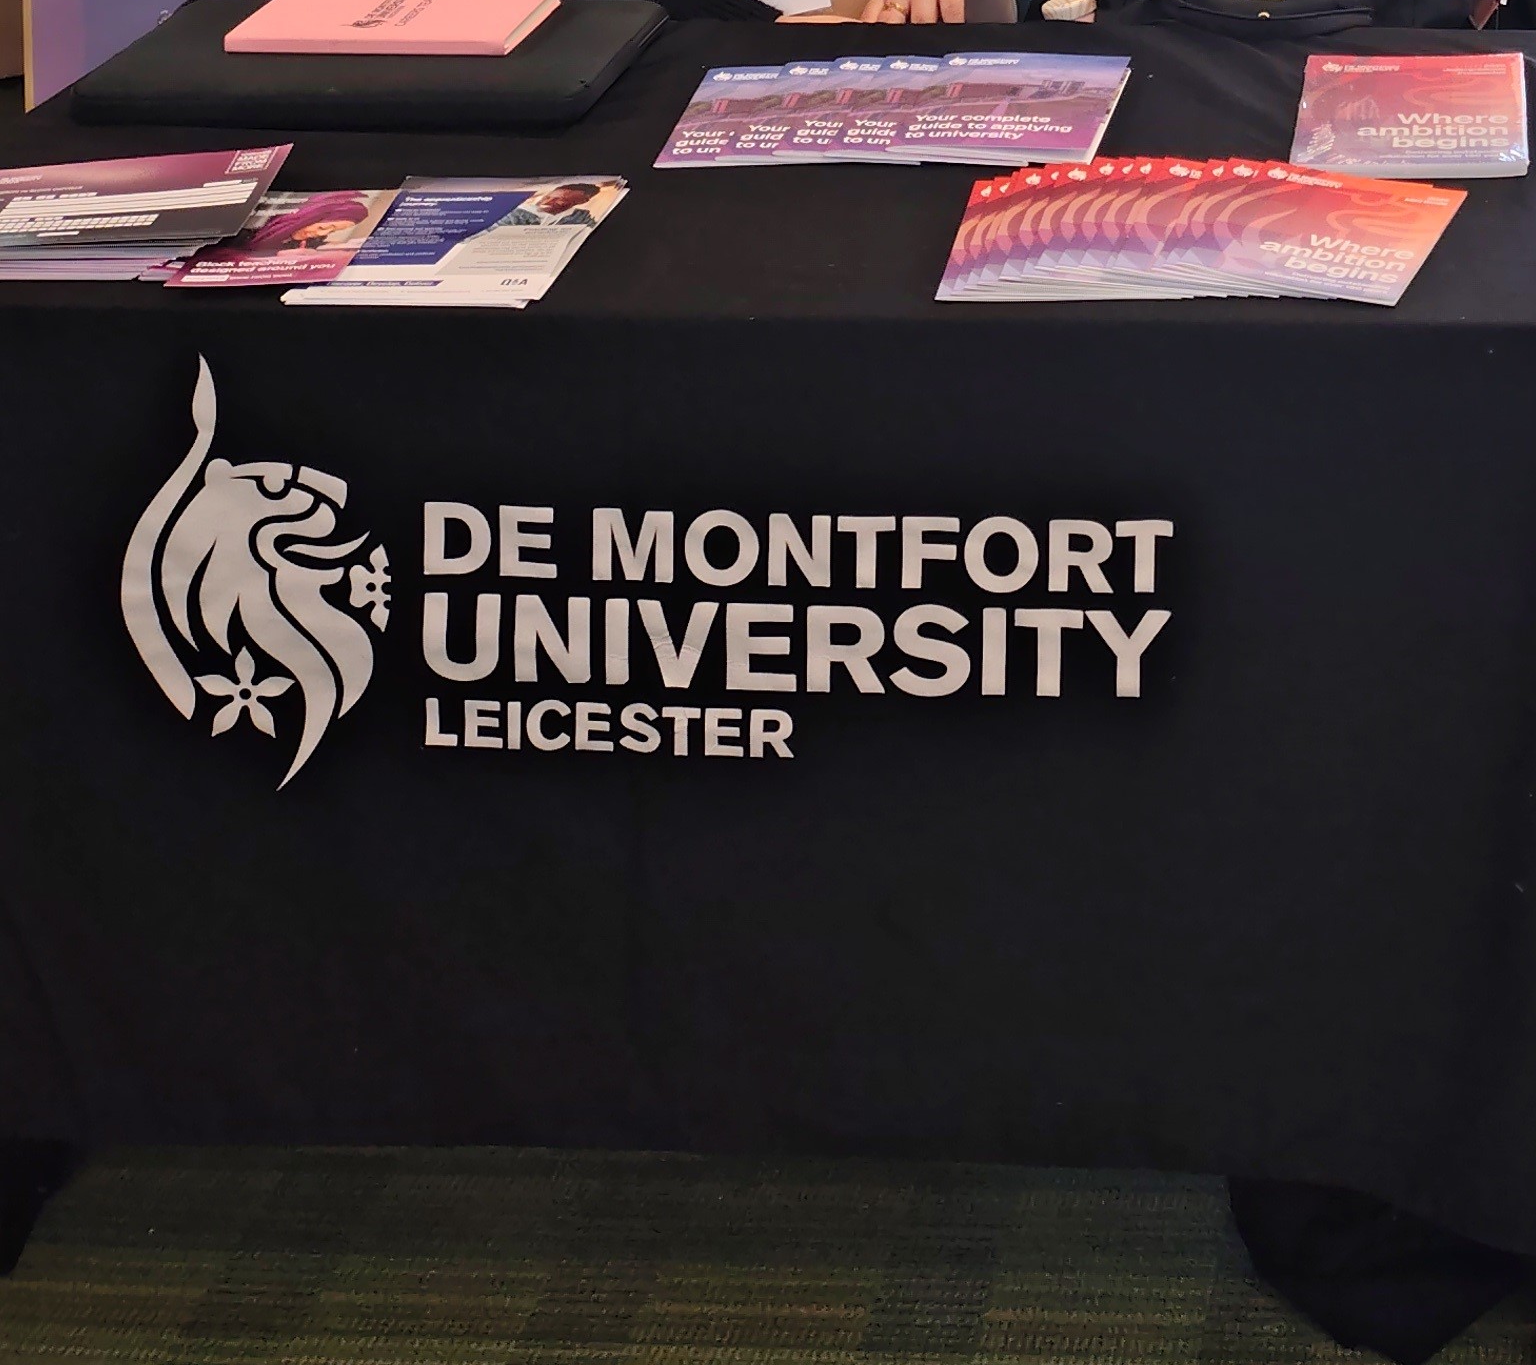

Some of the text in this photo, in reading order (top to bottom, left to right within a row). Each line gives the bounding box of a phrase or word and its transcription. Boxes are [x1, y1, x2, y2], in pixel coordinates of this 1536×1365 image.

[908, 122, 963, 131] guide
[990, 124, 1073, 133] applying
[915, 114, 1051, 123] Your complete
[1397, 113, 1508, 124] Where
[905, 129, 1024, 139] to university
[1357, 125, 1508, 137] ambition
[1392, 137, 1510, 149] begins
[1259, 241, 1406, 272] ambition
[1310, 234, 1415, 260] Where
[1284, 257, 1399, 284] begins
[424, 502, 1173, 593] DE MONTFORT
[423, 593, 1171, 697] UNIVERSITY
[425, 698, 794, 758] LEICESTER
